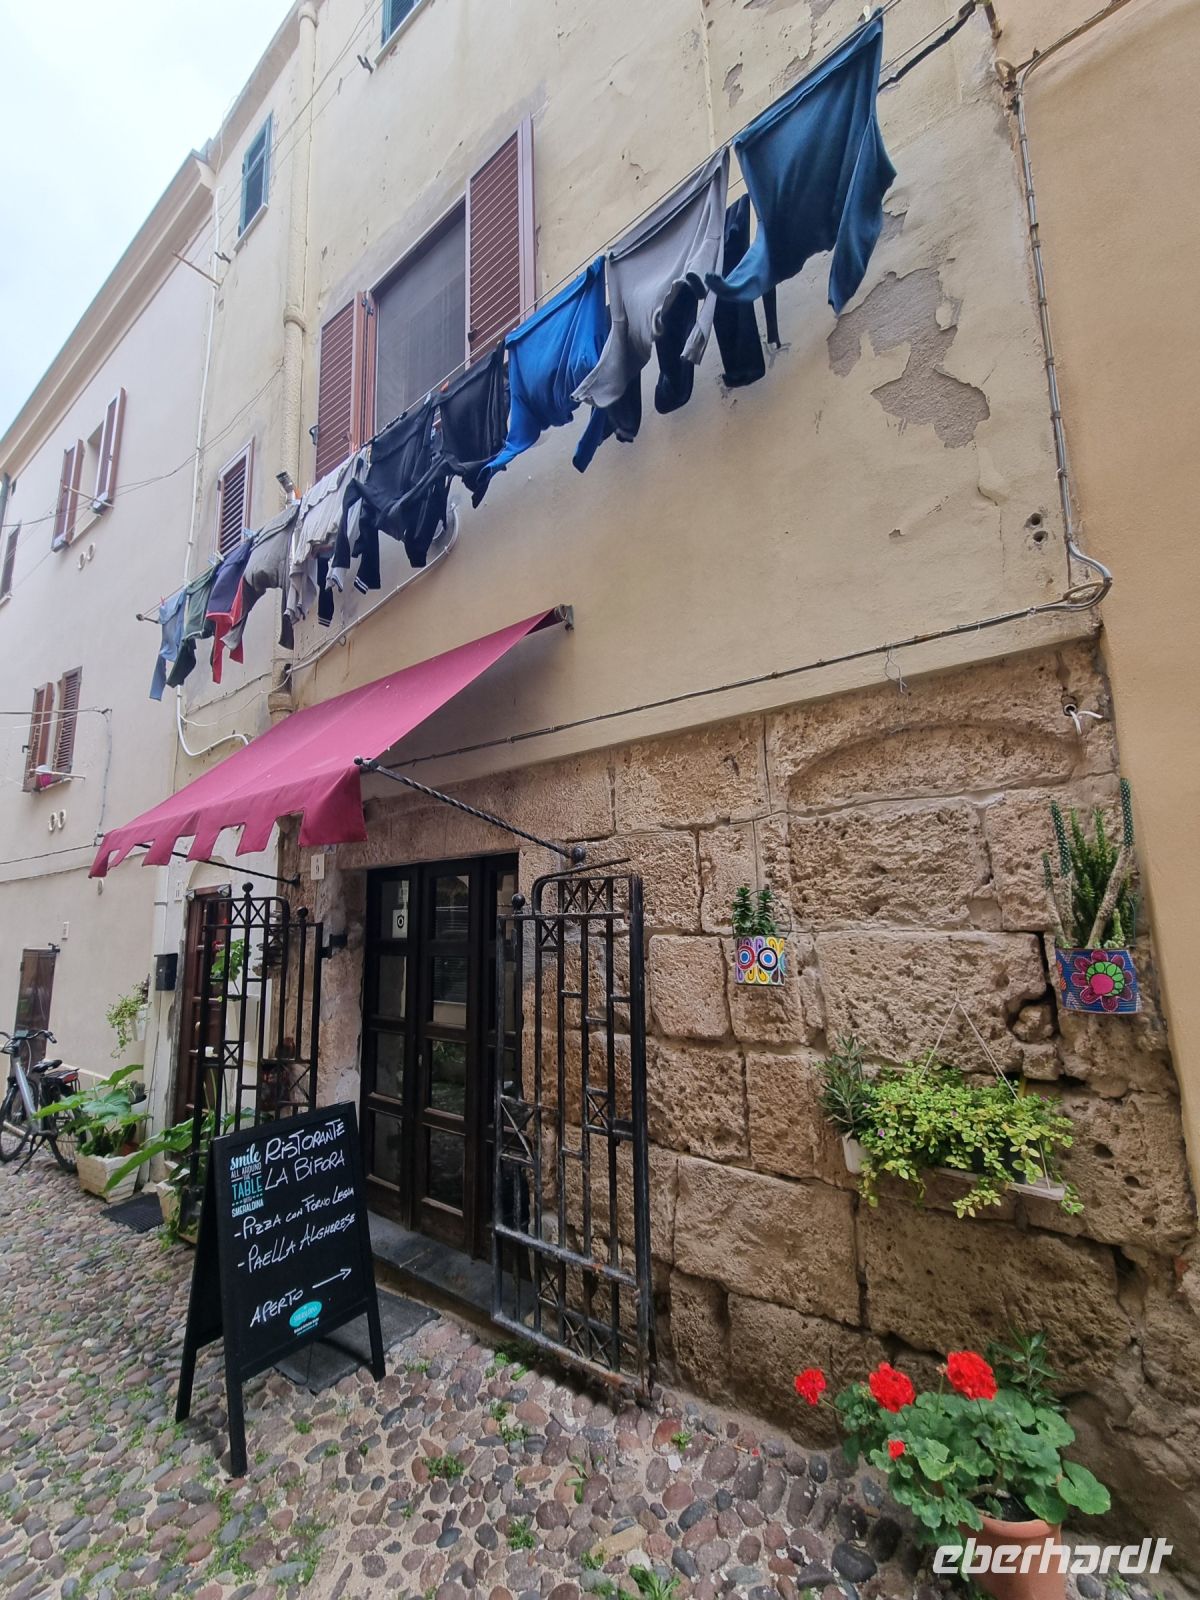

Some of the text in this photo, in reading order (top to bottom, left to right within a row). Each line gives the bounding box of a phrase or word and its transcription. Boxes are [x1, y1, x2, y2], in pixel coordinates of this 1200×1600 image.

[230, 1143, 261, 1170] smile
[231, 1162, 262, 1178] ALL AROUND
[265, 1167, 288, 1190] LA
[232, 1175, 263, 1200] TABLE
[232, 1198, 264, 1218] SMERALDINA
[250, 1288, 303, 1328] APERTO
